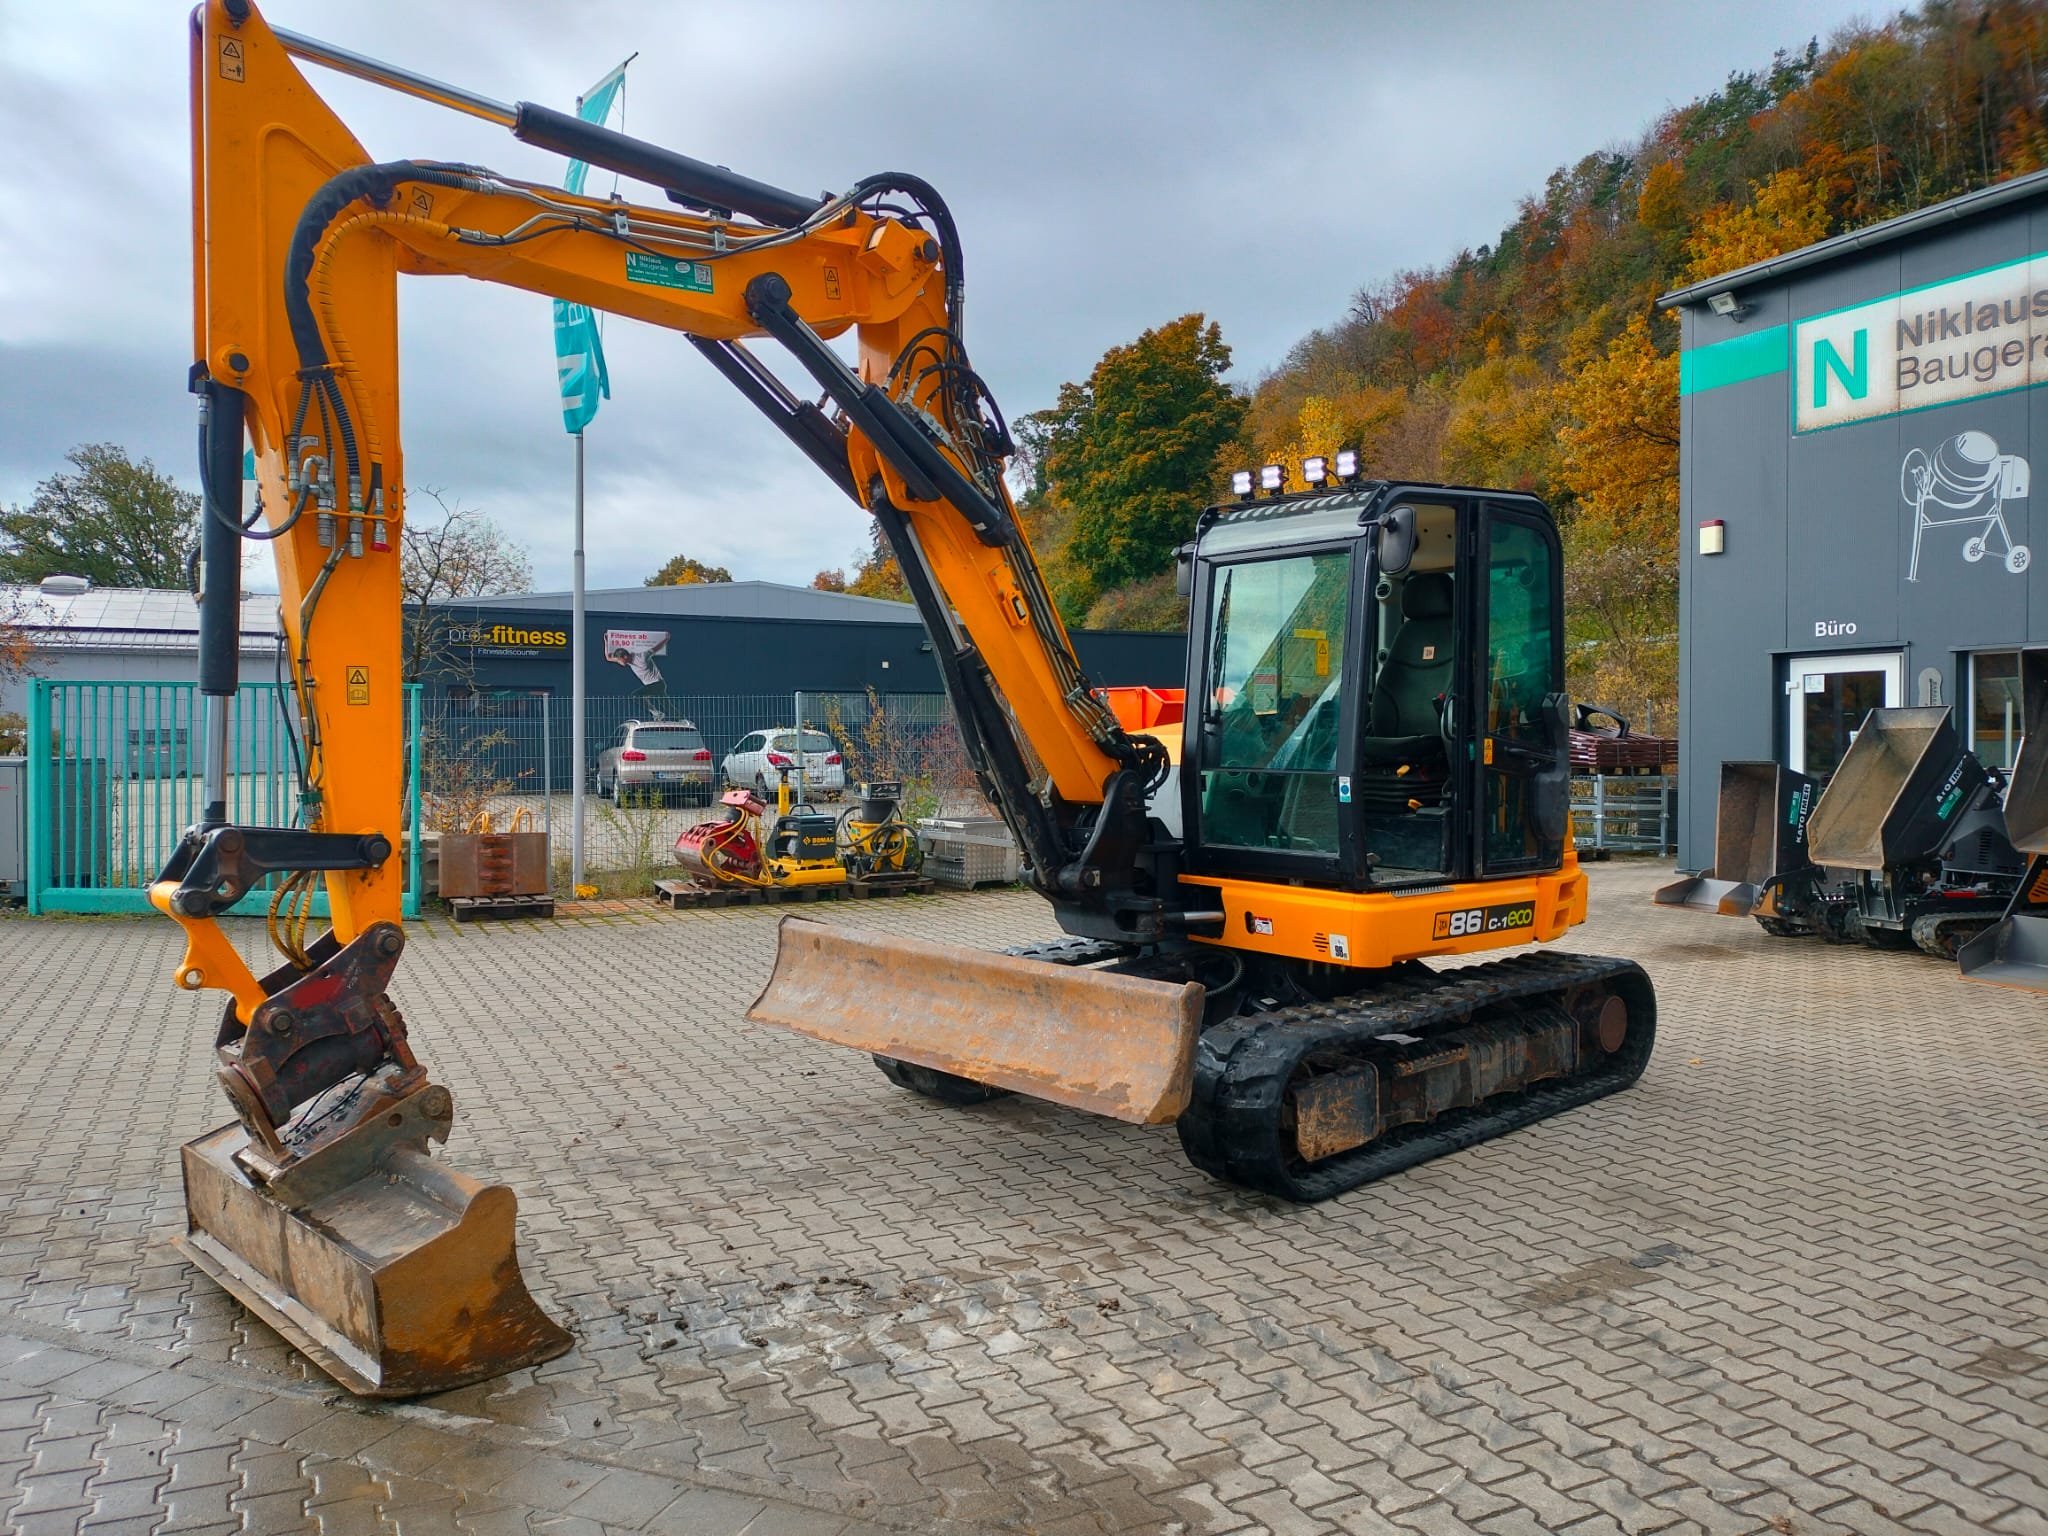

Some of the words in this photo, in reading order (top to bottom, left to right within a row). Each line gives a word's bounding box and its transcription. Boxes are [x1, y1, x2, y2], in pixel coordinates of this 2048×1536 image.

[626, 252, 636, 266] N
[1897, 289, 2048, 351] Niklaus
[1814, 328, 1867, 408] N
[1897, 334, 2048, 391] Bauger
[610, 632, 637, 640] Fitness
[1814, 620, 1857, 637] Büro
[477, 647, 540, 656] Fitnessdiscounter
[1795, 816, 1805, 843] KATO
[1449, 909, 1483, 936] 86
[1507, 908, 1533, 927] eco
